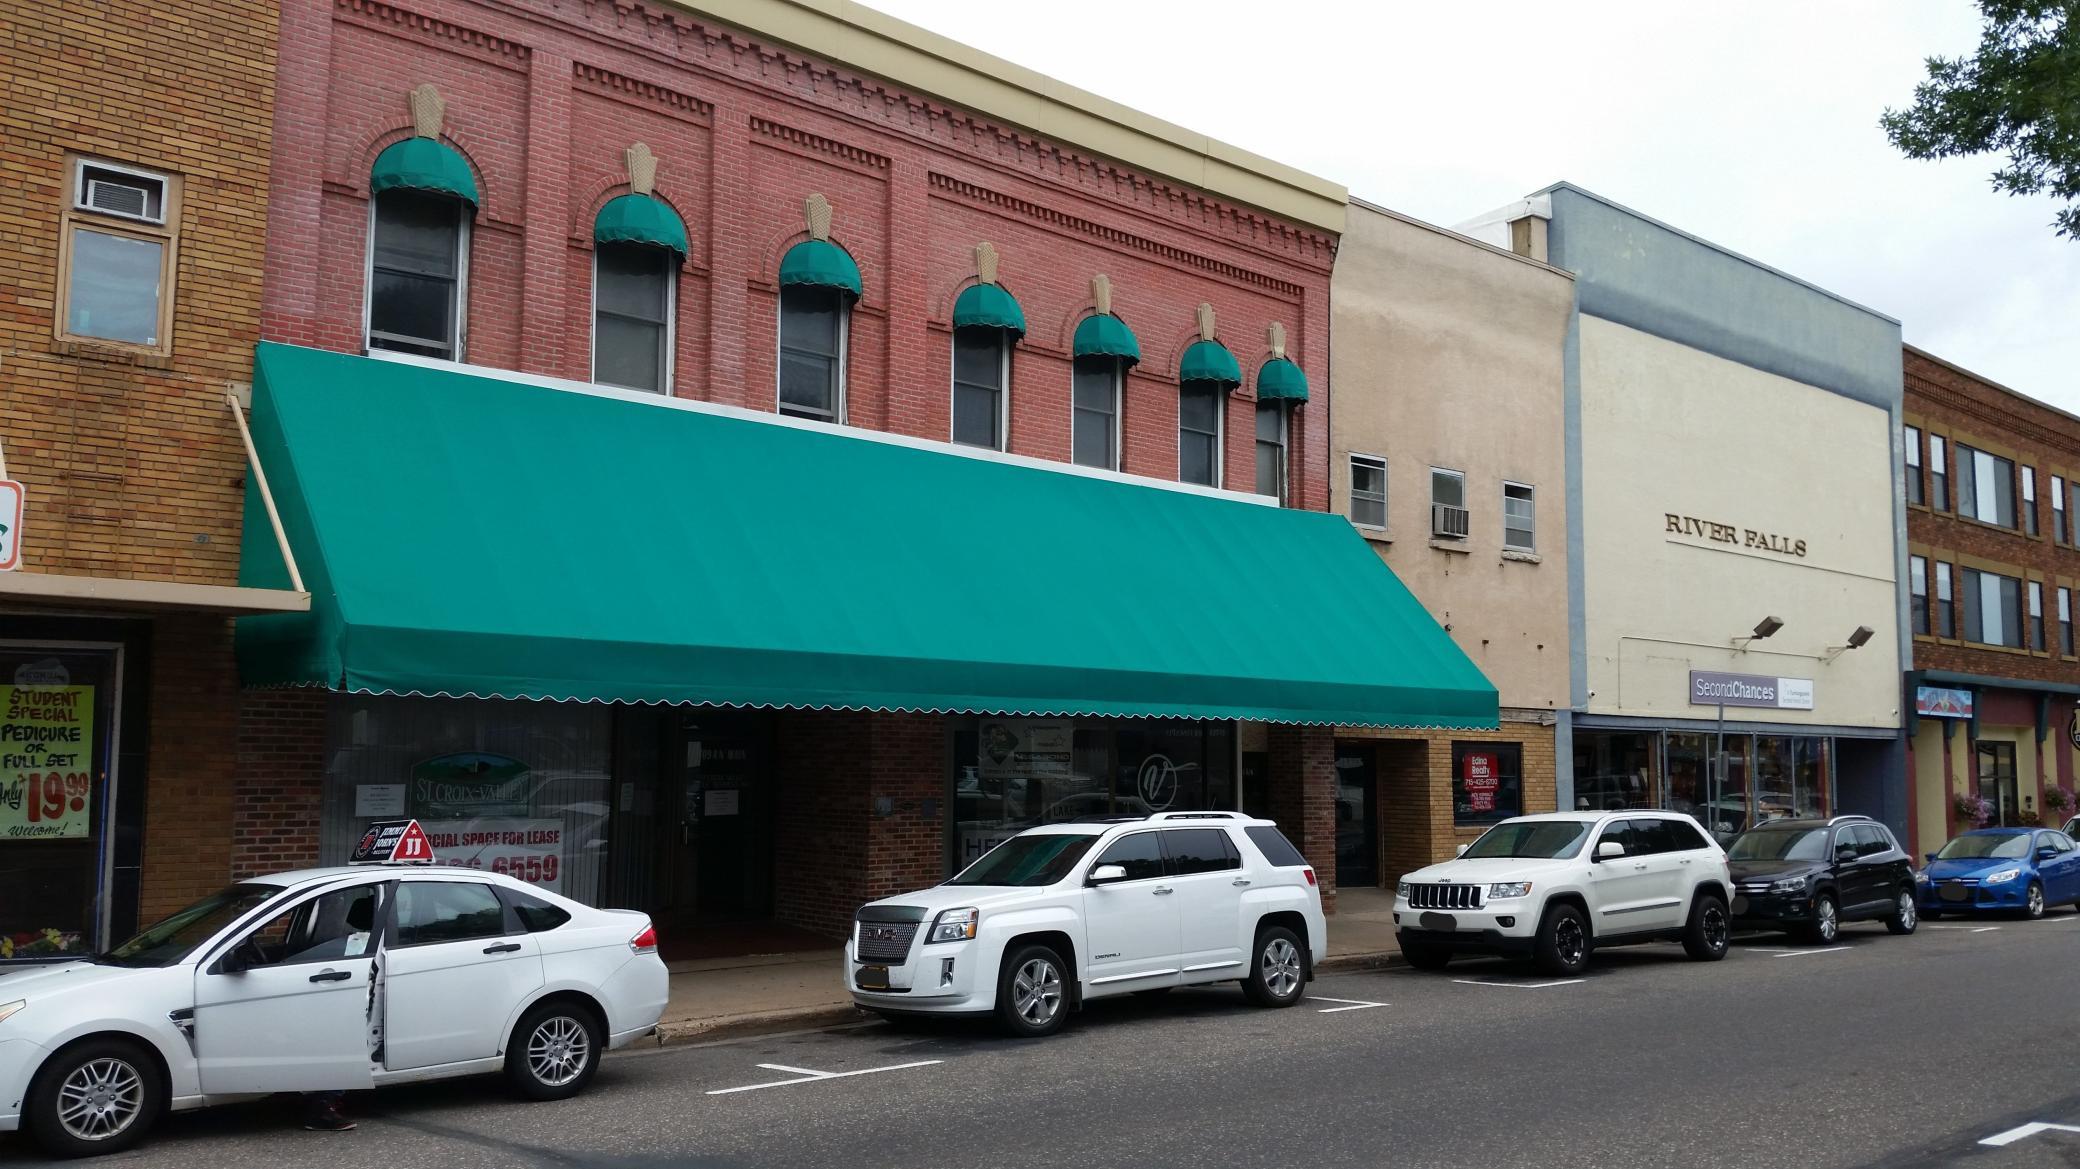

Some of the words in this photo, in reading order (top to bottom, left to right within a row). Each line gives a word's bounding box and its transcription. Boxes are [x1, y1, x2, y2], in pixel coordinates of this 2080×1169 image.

[1665, 513, 1738, 544] RIVER
[1744, 529, 1807, 557] FALLS
[9, 688, 82, 707] STUDENT
[1696, 679, 1774, 700] SecondChances
[6, 706, 79, 722] SPECIAL
[1, 724, 81, 742] PEDICURE
[25, 743, 47, 753] OR
[3, 754, 41, 768] FULL
[45, 754, 78, 767] SET
[1472, 766, 1490, 776] Realty
[462, 832, 499, 846] SPACE
[502, 832, 524, 844] FOR
[527, 830, 560, 844] LEASE
[405, 838, 422, 855] JJ
